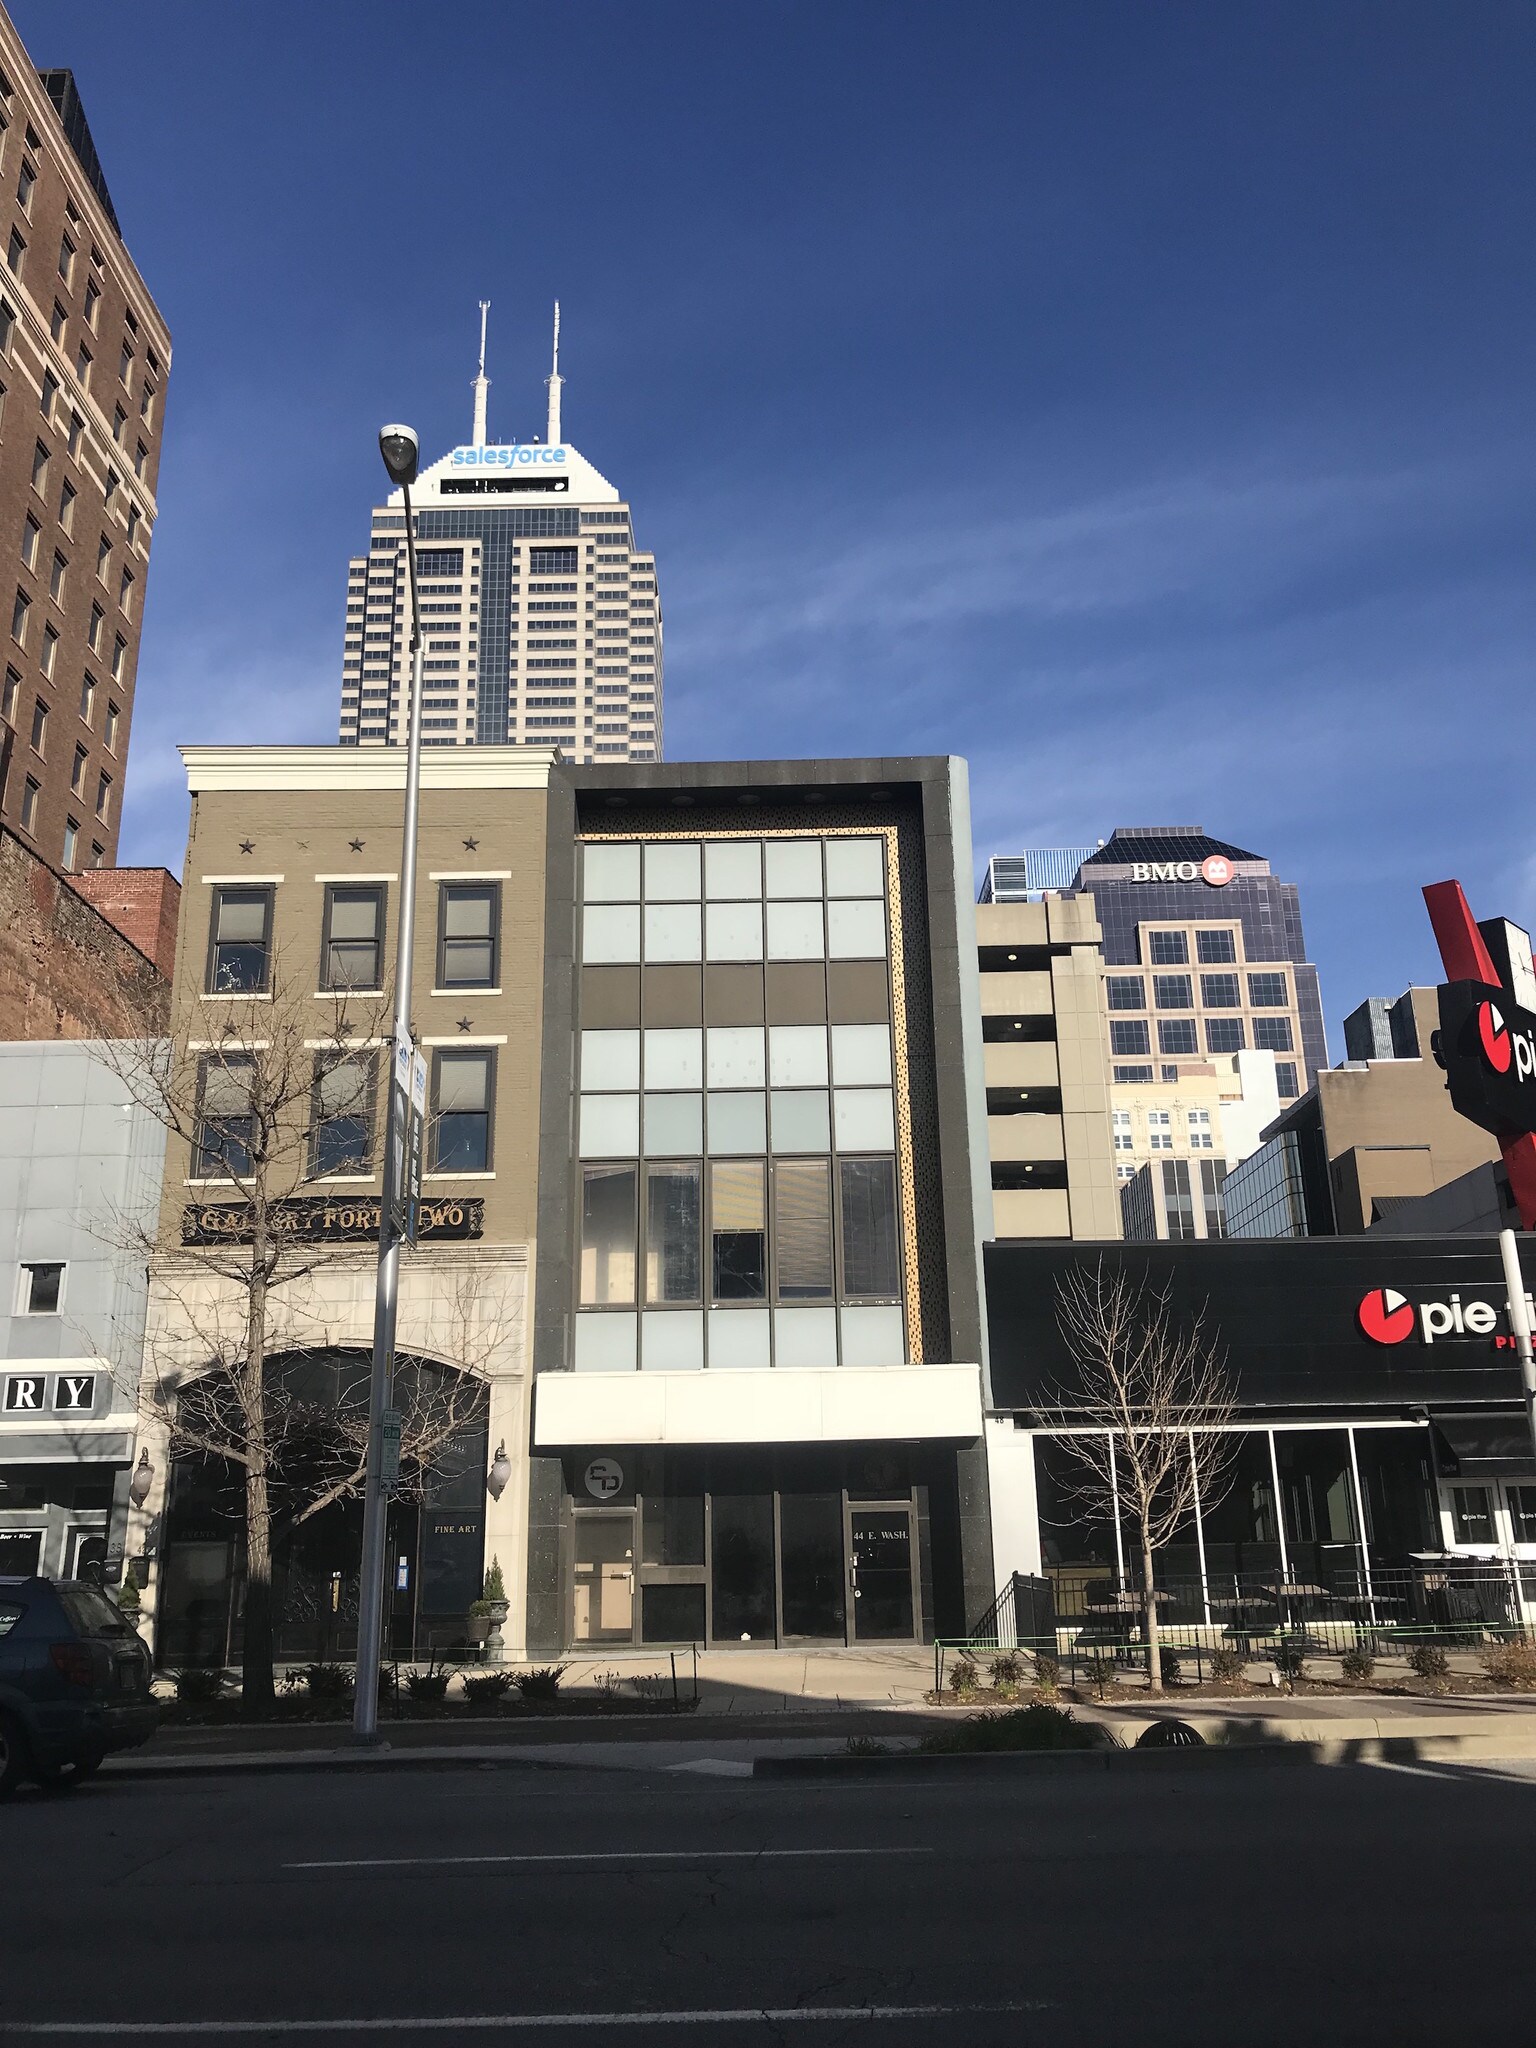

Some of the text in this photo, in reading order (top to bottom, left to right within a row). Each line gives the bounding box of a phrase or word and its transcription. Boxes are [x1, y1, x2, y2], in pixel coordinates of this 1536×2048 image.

[453, 444, 566, 468] salesforce
[1130, 861, 1198, 882] BMO
[322, 1207, 382, 1229] FORT
[1419, 1293, 1497, 1344] pie
[995, 1416, 1005, 1424] 48
[434, 1525, 477, 1534] FINE ART
[853, 1530, 909, 1540] 44 E. WASH.
